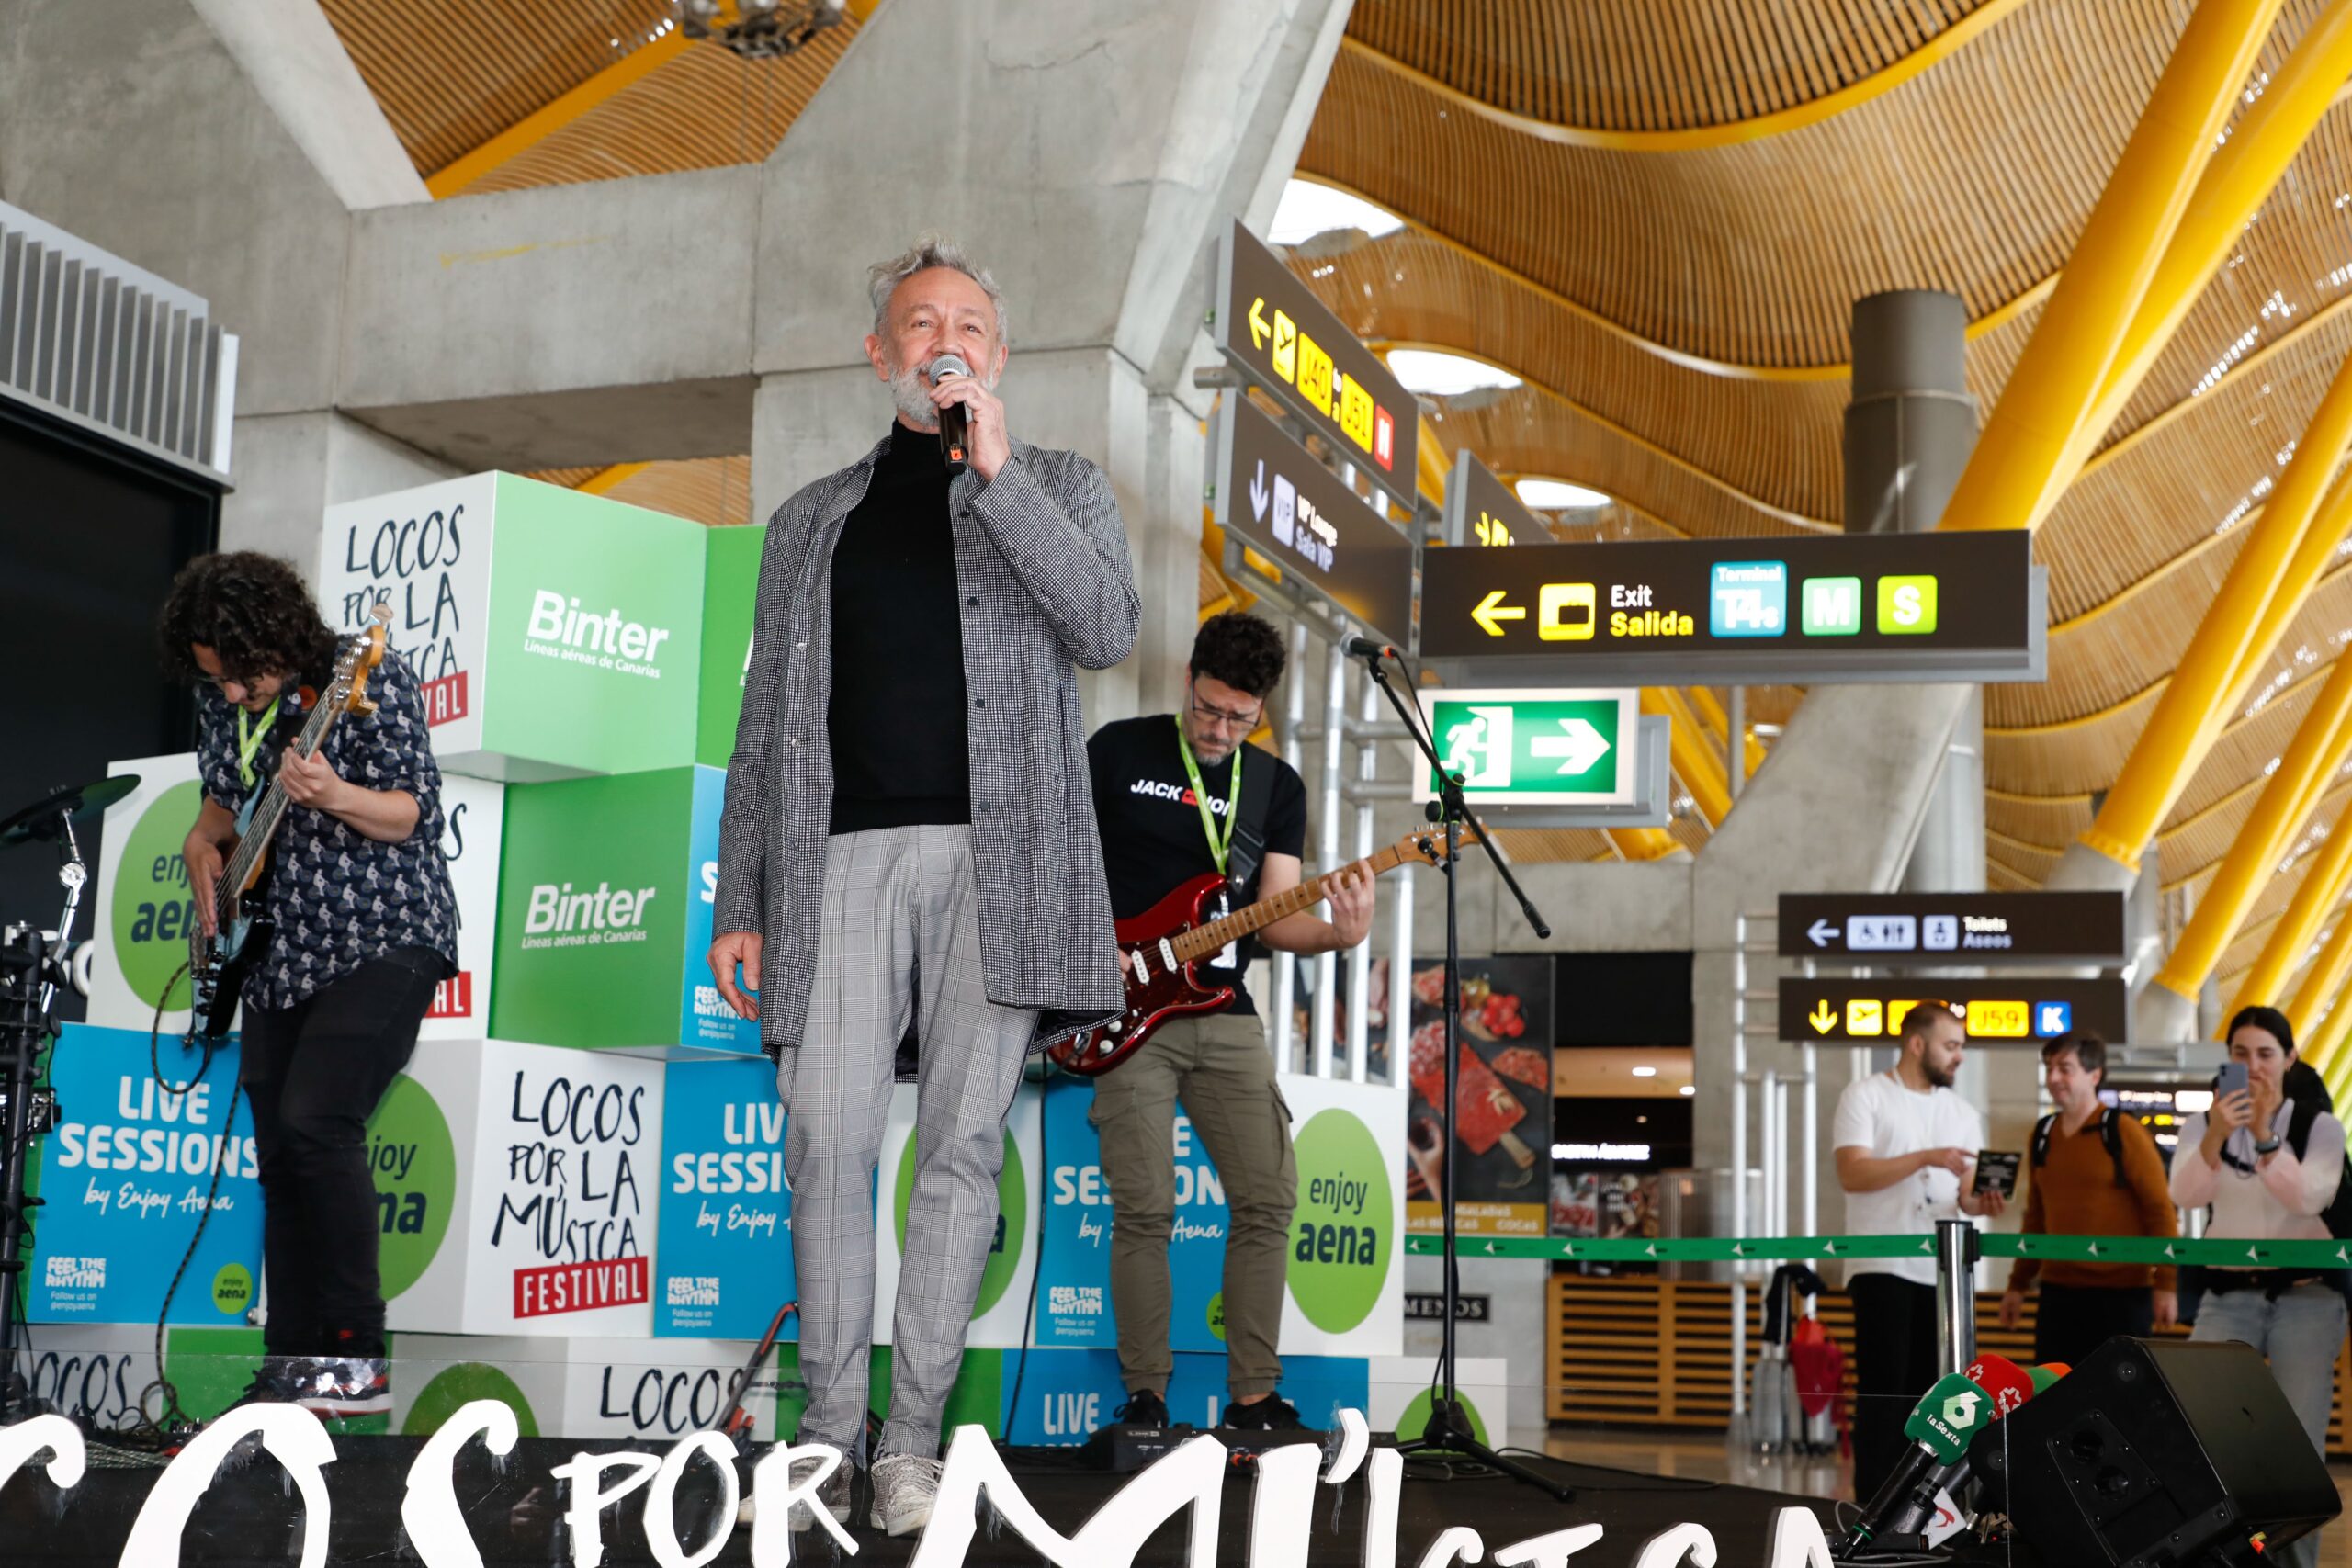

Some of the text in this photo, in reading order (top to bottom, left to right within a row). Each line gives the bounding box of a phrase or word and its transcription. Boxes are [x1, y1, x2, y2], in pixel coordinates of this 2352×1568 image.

[346, 503, 464, 580] LOCOS
[1716, 565, 1781, 582] Terminal
[405, 571, 460, 640] LA
[1611, 585, 1653, 608] Exit
[1812, 588, 1850, 626] M
[1893, 585, 1922, 626] S
[526, 589, 669, 662] Binter
[1610, 610, 1694, 637] Salida
[560, 649, 596, 666] aéreas
[598, 655, 613, 669] de
[615, 658, 661, 680] Canarias
[1130, 779, 1183, 801] JACK
[525, 882, 655, 934] Binter
[554, 934, 586, 947] aéreas
[588, 931, 601, 944] de
[604, 929, 647, 943] Canarias
[1980, 1010, 2018, 1029] J59
[2042, 1006, 2064, 1033] K
[118, 1075, 210, 1125] LIVE
[512, 1070, 645, 1146] LOCOS
[724, 1102, 786, 1145] LIV
[58, 1122, 260, 1179] SESSIONS
[507, 1141, 640, 1218] POR LA
[673, 1151, 793, 1194] SESSI
[1309, 1171, 1368, 1215] enjoy
[84, 1176, 111, 1216] by
[117, 1181, 172, 1219] Enjoy
[491, 1184, 639, 1265] MÚSICA
[696, 1200, 720, 1237] by
[727, 1203, 776, 1239] Enjoy
[1078, 1213, 1102, 1248] by
[1171, 1215, 1224, 1243] Aena
[1295, 1222, 1376, 1266] aena
[45, 1269, 106, 1288] RHYTHM
[47, 1256, 107, 1276] FEEL THE
[667, 1276, 719, 1295] FEEL THE
[523, 1262, 641, 1314] FESTIVAL
[667, 1288, 719, 1305] RHYTHM
[1049, 1286, 1102, 1303] FEEL THE
[1049, 1297, 1102, 1315] RHYTHM
[30, 1351, 131, 1421] OCOS
[1044, 1393, 1100, 1435] LIVE
[1927, 1414, 1961, 1446] laSexta
[550, 1430, 860, 1568] POR
